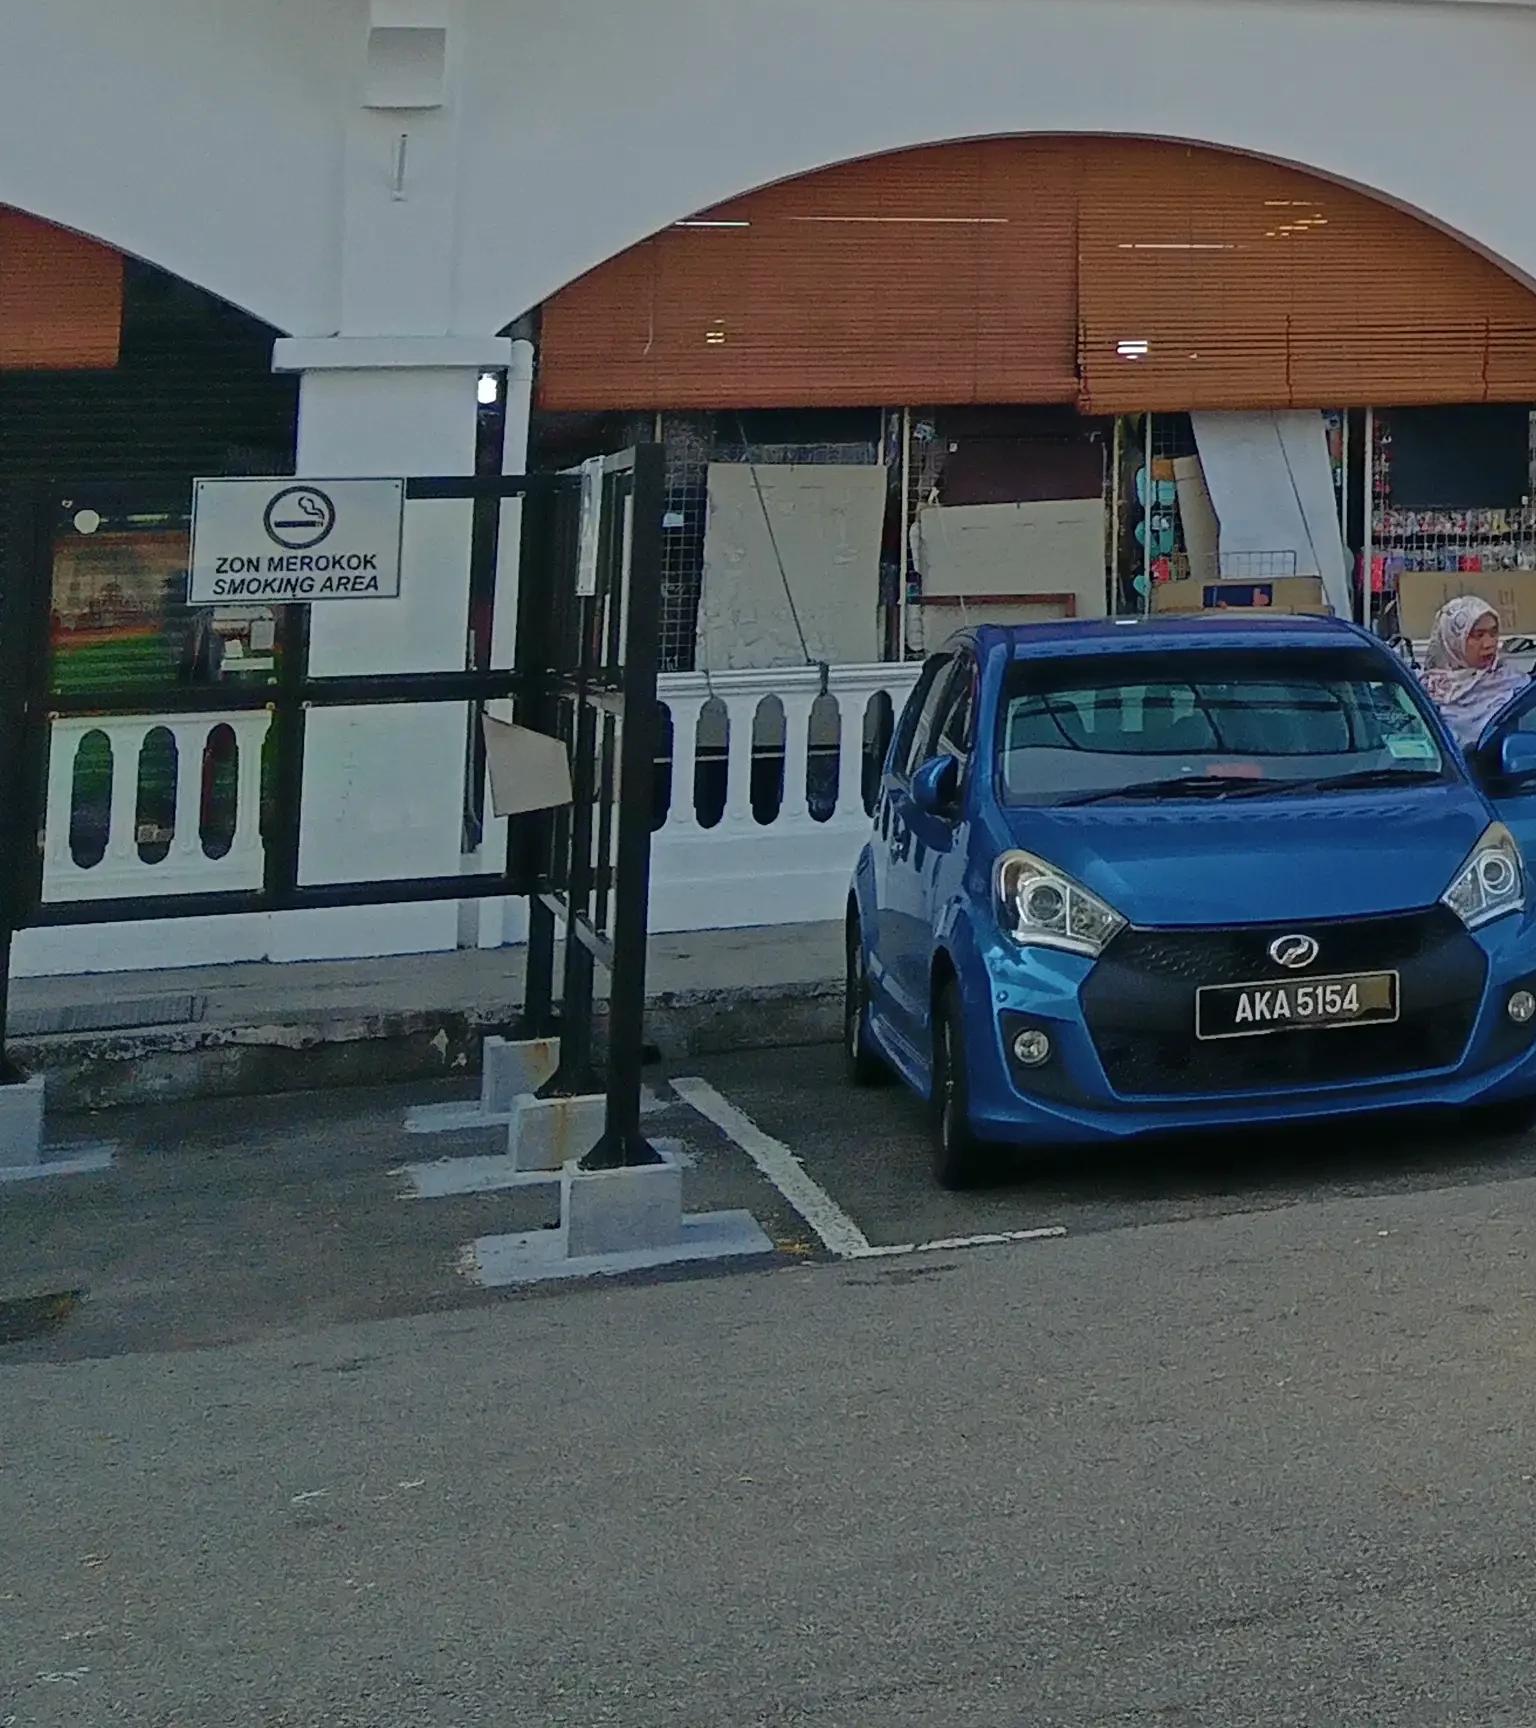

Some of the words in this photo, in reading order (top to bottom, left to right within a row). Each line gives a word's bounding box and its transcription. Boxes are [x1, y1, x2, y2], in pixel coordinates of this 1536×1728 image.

[215, 556, 261, 574] ZON
[267, 554, 377, 572] MEROKOK
[212, 576, 316, 595] SMOKING
[319, 575, 379, 593] AREA
[1235, 989, 1291, 1023] AKA
[1297, 983, 1360, 1016] 5154
